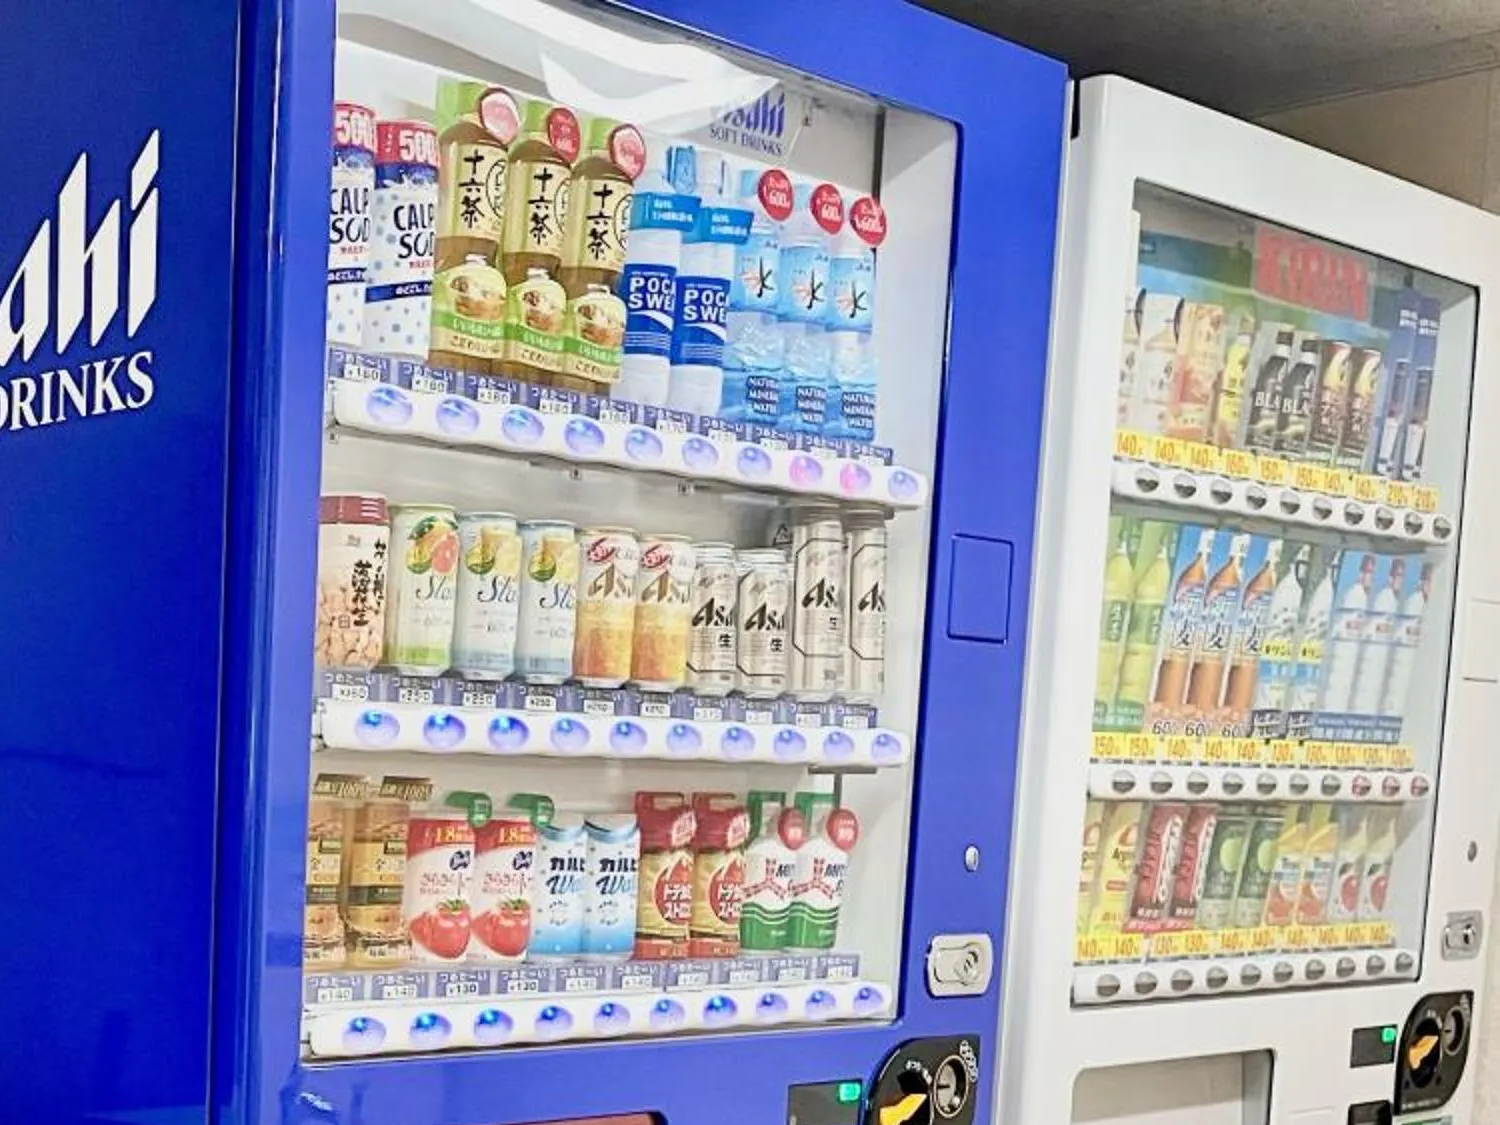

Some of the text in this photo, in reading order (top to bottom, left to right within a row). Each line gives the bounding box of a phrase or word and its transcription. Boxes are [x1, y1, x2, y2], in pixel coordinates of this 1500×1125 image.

[459, 150, 485, 229] 十六茶
[528, 167, 553, 245] 十六茶
[587, 184, 613, 260] 十六茶
